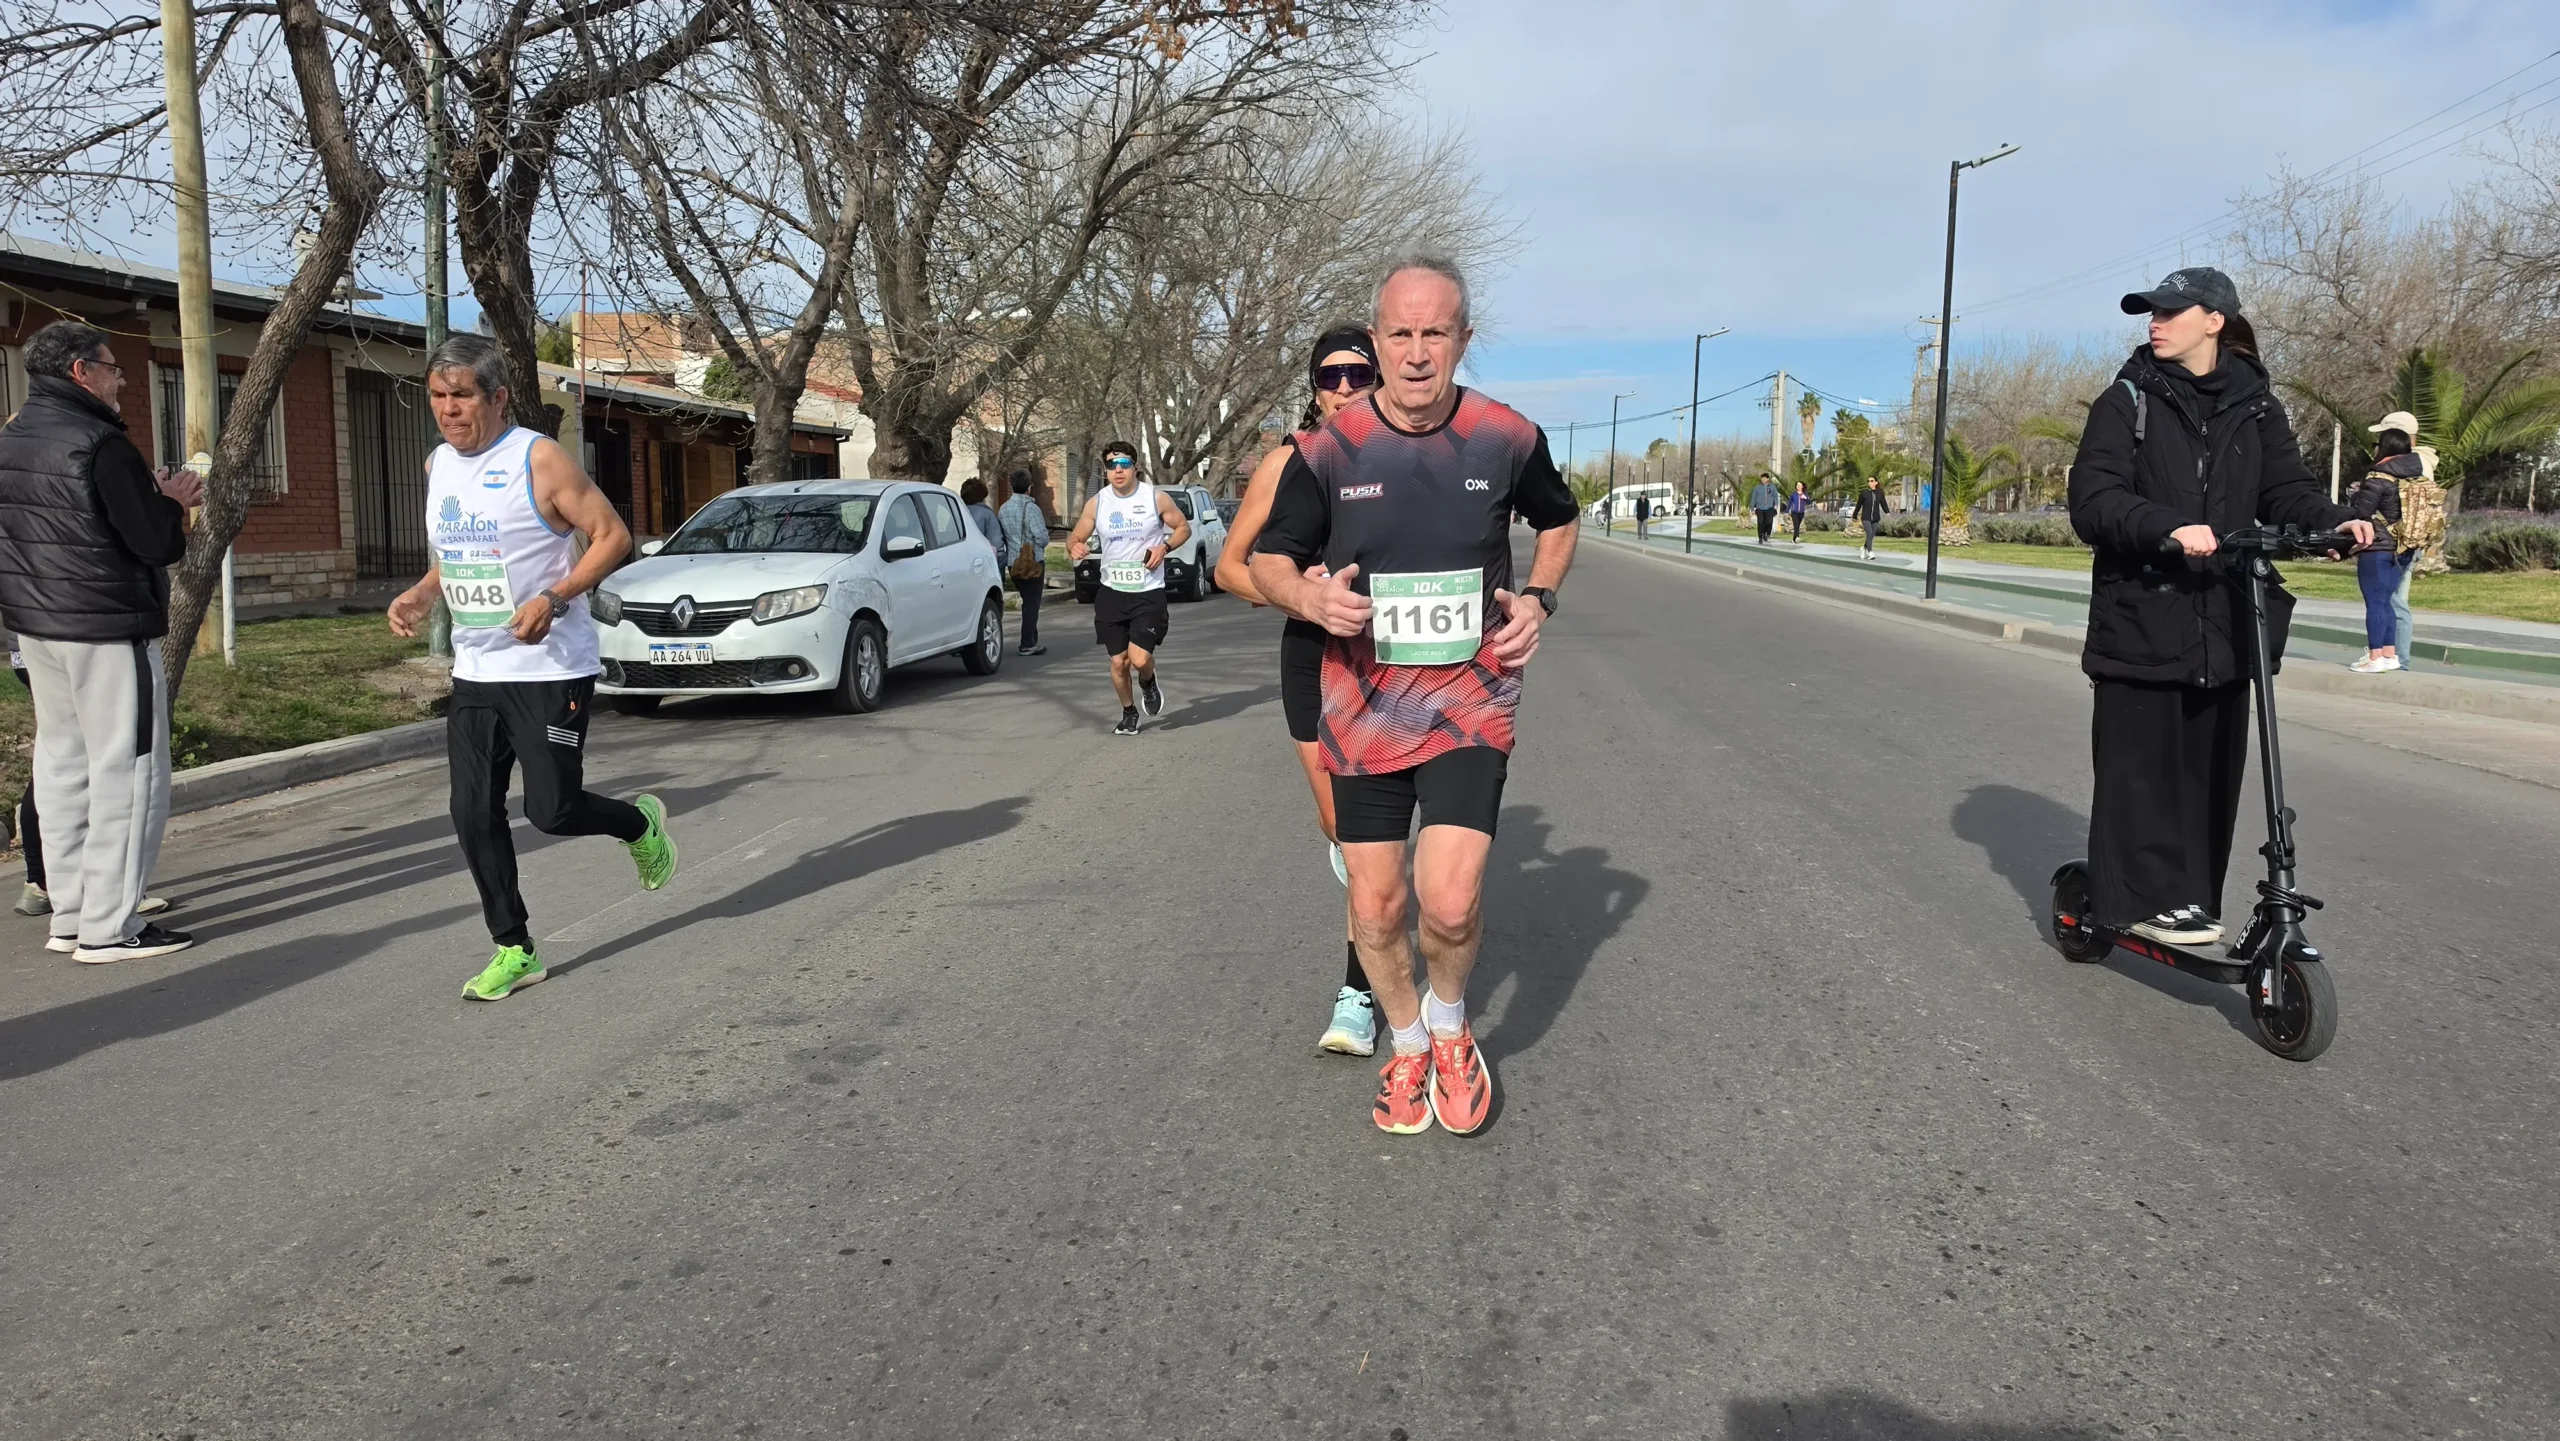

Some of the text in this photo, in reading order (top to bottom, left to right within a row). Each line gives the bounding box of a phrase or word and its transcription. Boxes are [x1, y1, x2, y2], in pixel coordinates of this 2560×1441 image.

[1341, 484, 1381, 498] PUSH
[447, 535, 465, 544] SAN
[466, 534, 500, 543] RAFAEL
[455, 568, 476, 578] 10K
[1111, 570, 1142, 581] 1163
[1412, 581, 1444, 594] 10K
[445, 583, 506, 606] 1048
[1383, 602, 1470, 634] 1161
[653, 650, 710, 662] AA 264 VU
